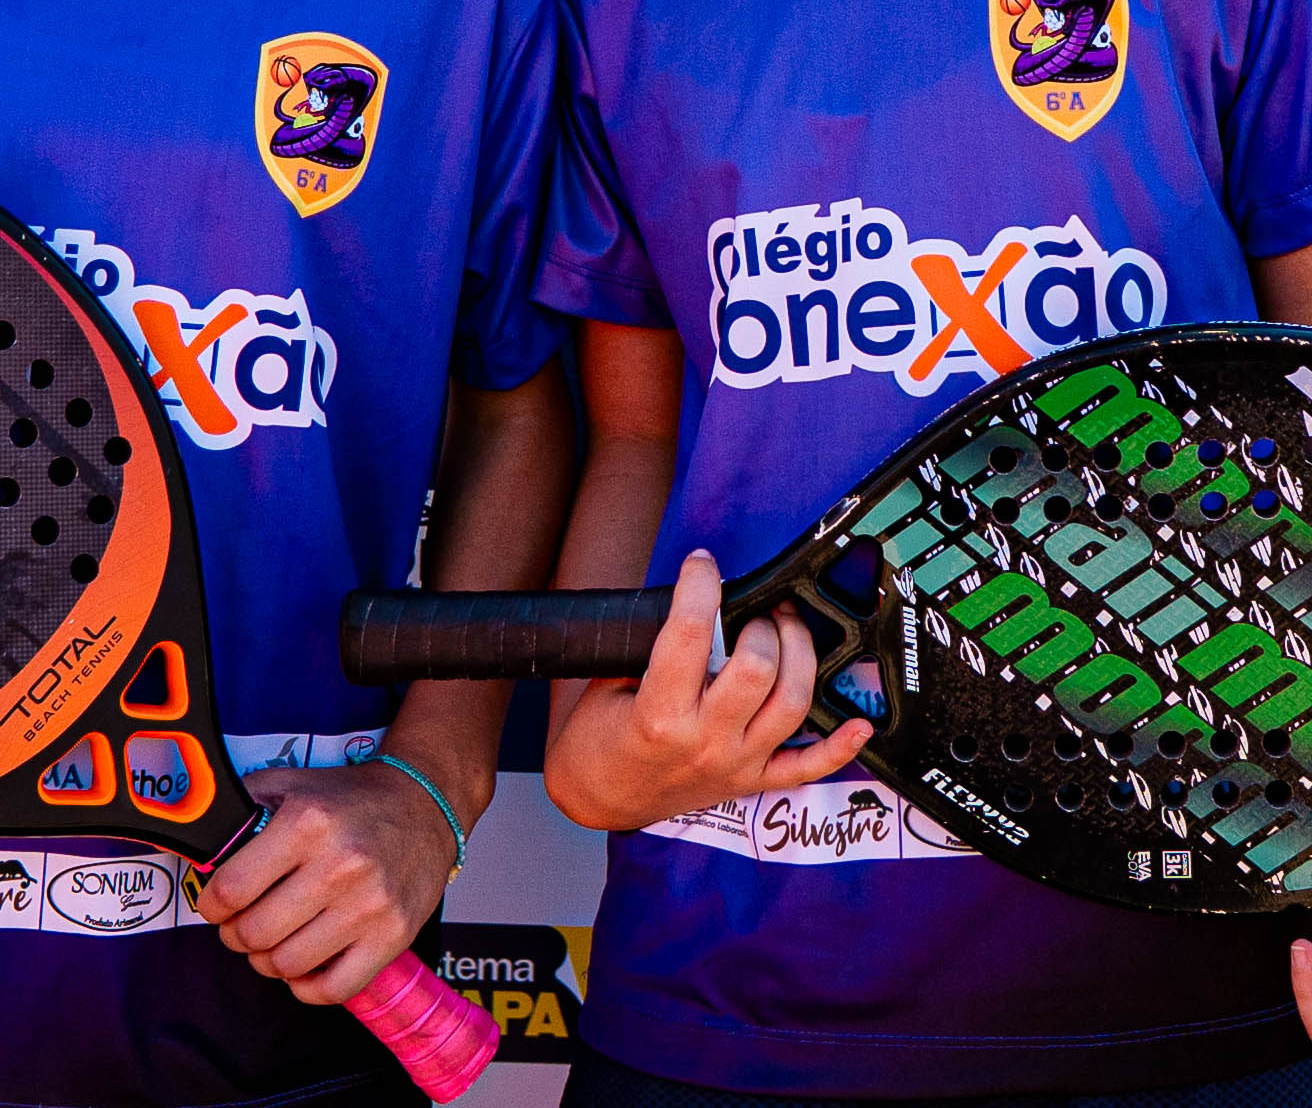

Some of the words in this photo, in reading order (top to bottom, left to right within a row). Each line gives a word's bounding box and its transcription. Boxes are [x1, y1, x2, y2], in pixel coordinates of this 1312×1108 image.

[901, 606, 920, 693] mormaii
[23, 689, 72, 742] BEACH
[72, 631, 123, 685] TENNIS
[763, 797, 891, 857] Silvestre
[1137, 850, 1152, 882] EVA
[437, 951, 535, 982] tema
